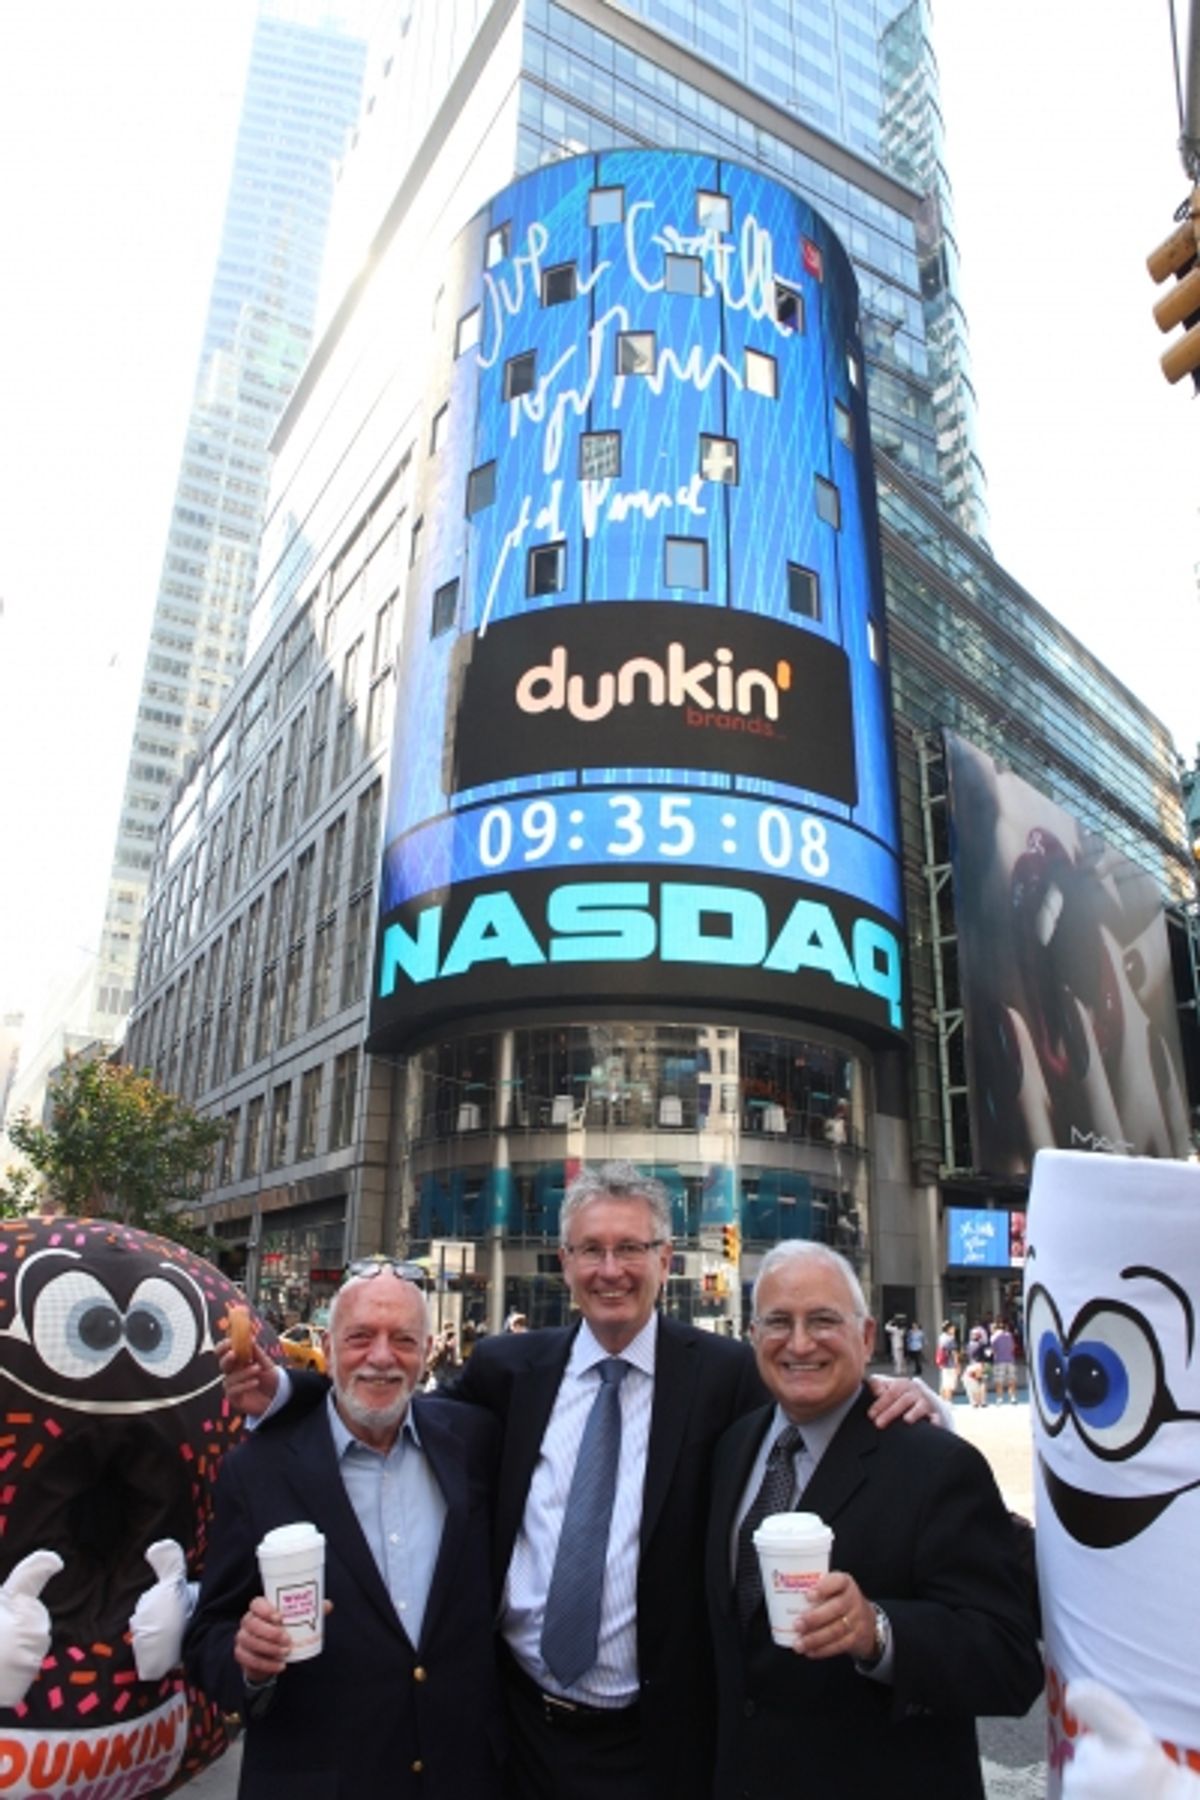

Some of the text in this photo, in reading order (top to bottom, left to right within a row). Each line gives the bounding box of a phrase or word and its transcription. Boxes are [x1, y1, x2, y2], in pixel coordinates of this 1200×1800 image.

[516, 642, 791, 722] dunkin'
[686, 706, 775, 738] brands
[380, 882, 903, 1030] NASDAQ
